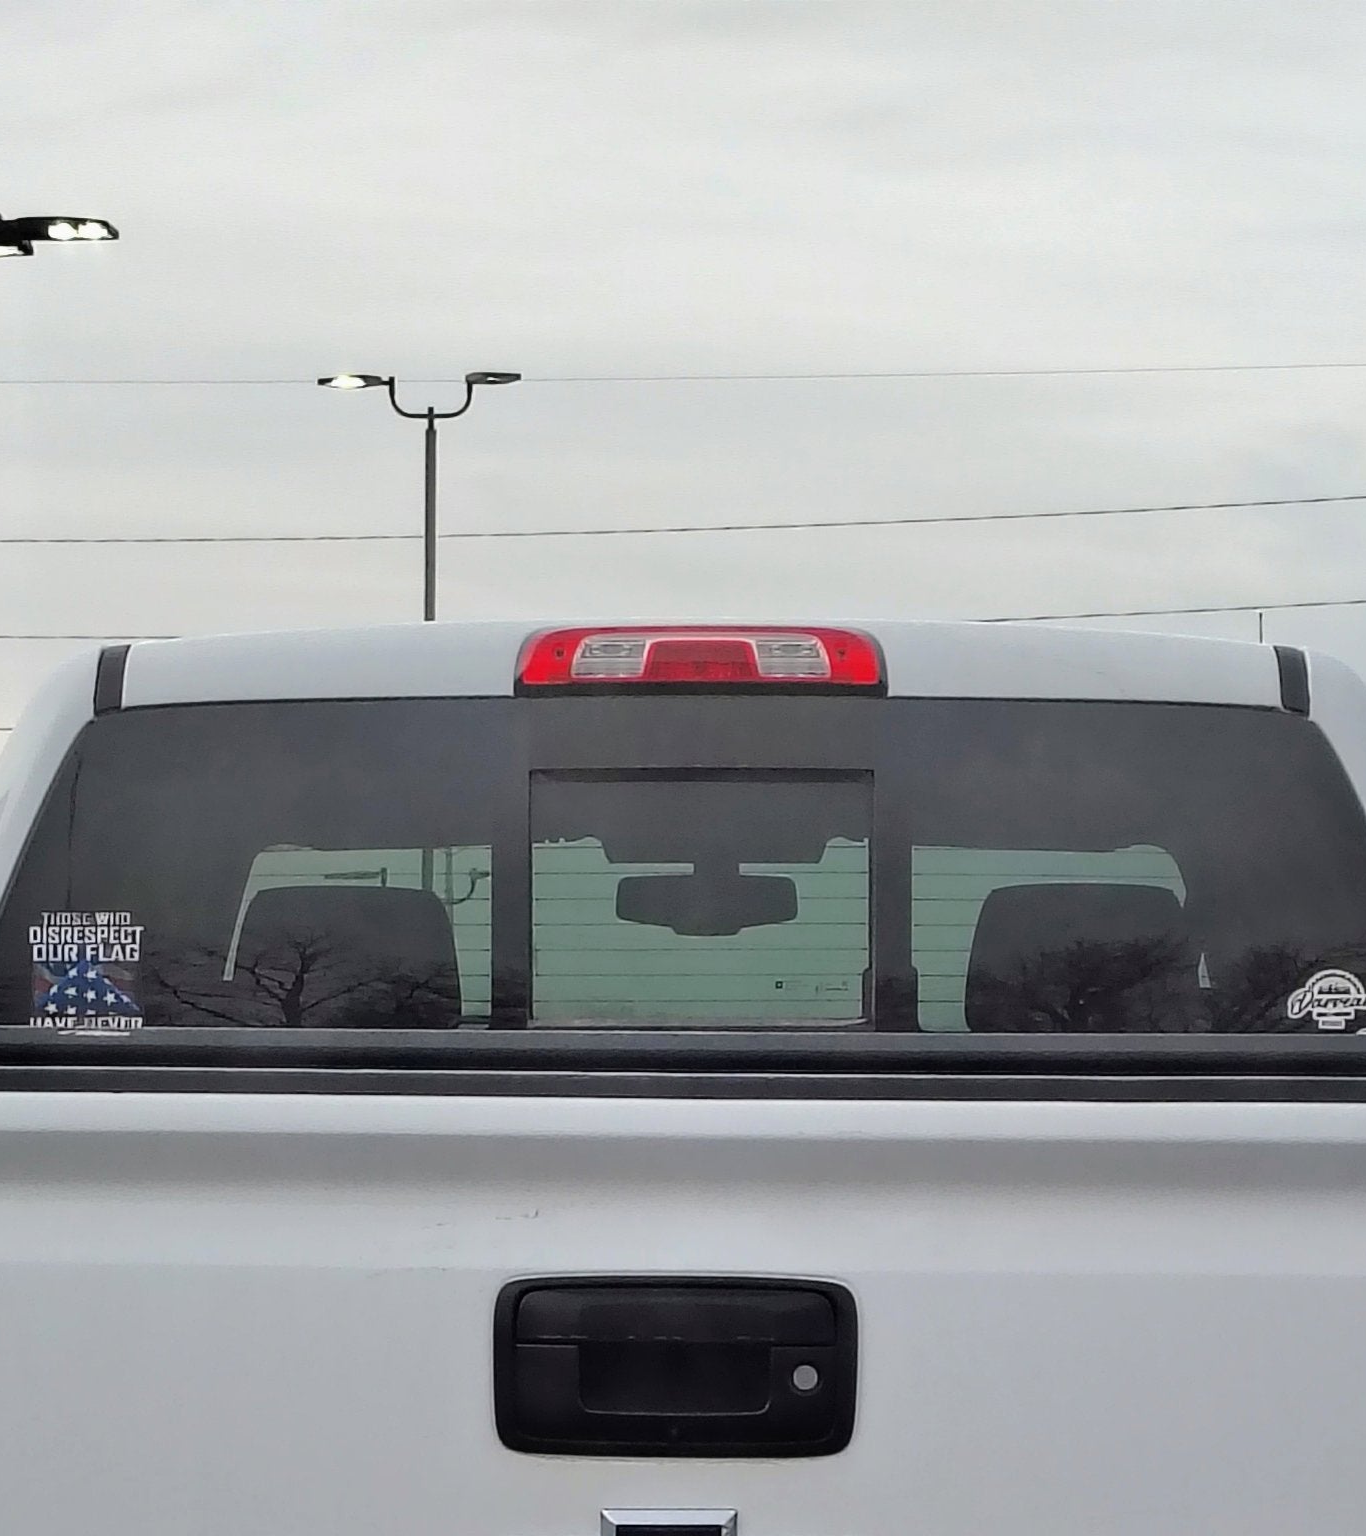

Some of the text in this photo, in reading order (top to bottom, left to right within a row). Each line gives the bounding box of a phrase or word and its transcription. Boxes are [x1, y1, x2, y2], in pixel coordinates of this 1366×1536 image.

[41, 911, 131, 926] THOSE WHO
[28, 926, 145, 944] DISRESPECT
[32, 944, 140, 962] OUR FLAG
